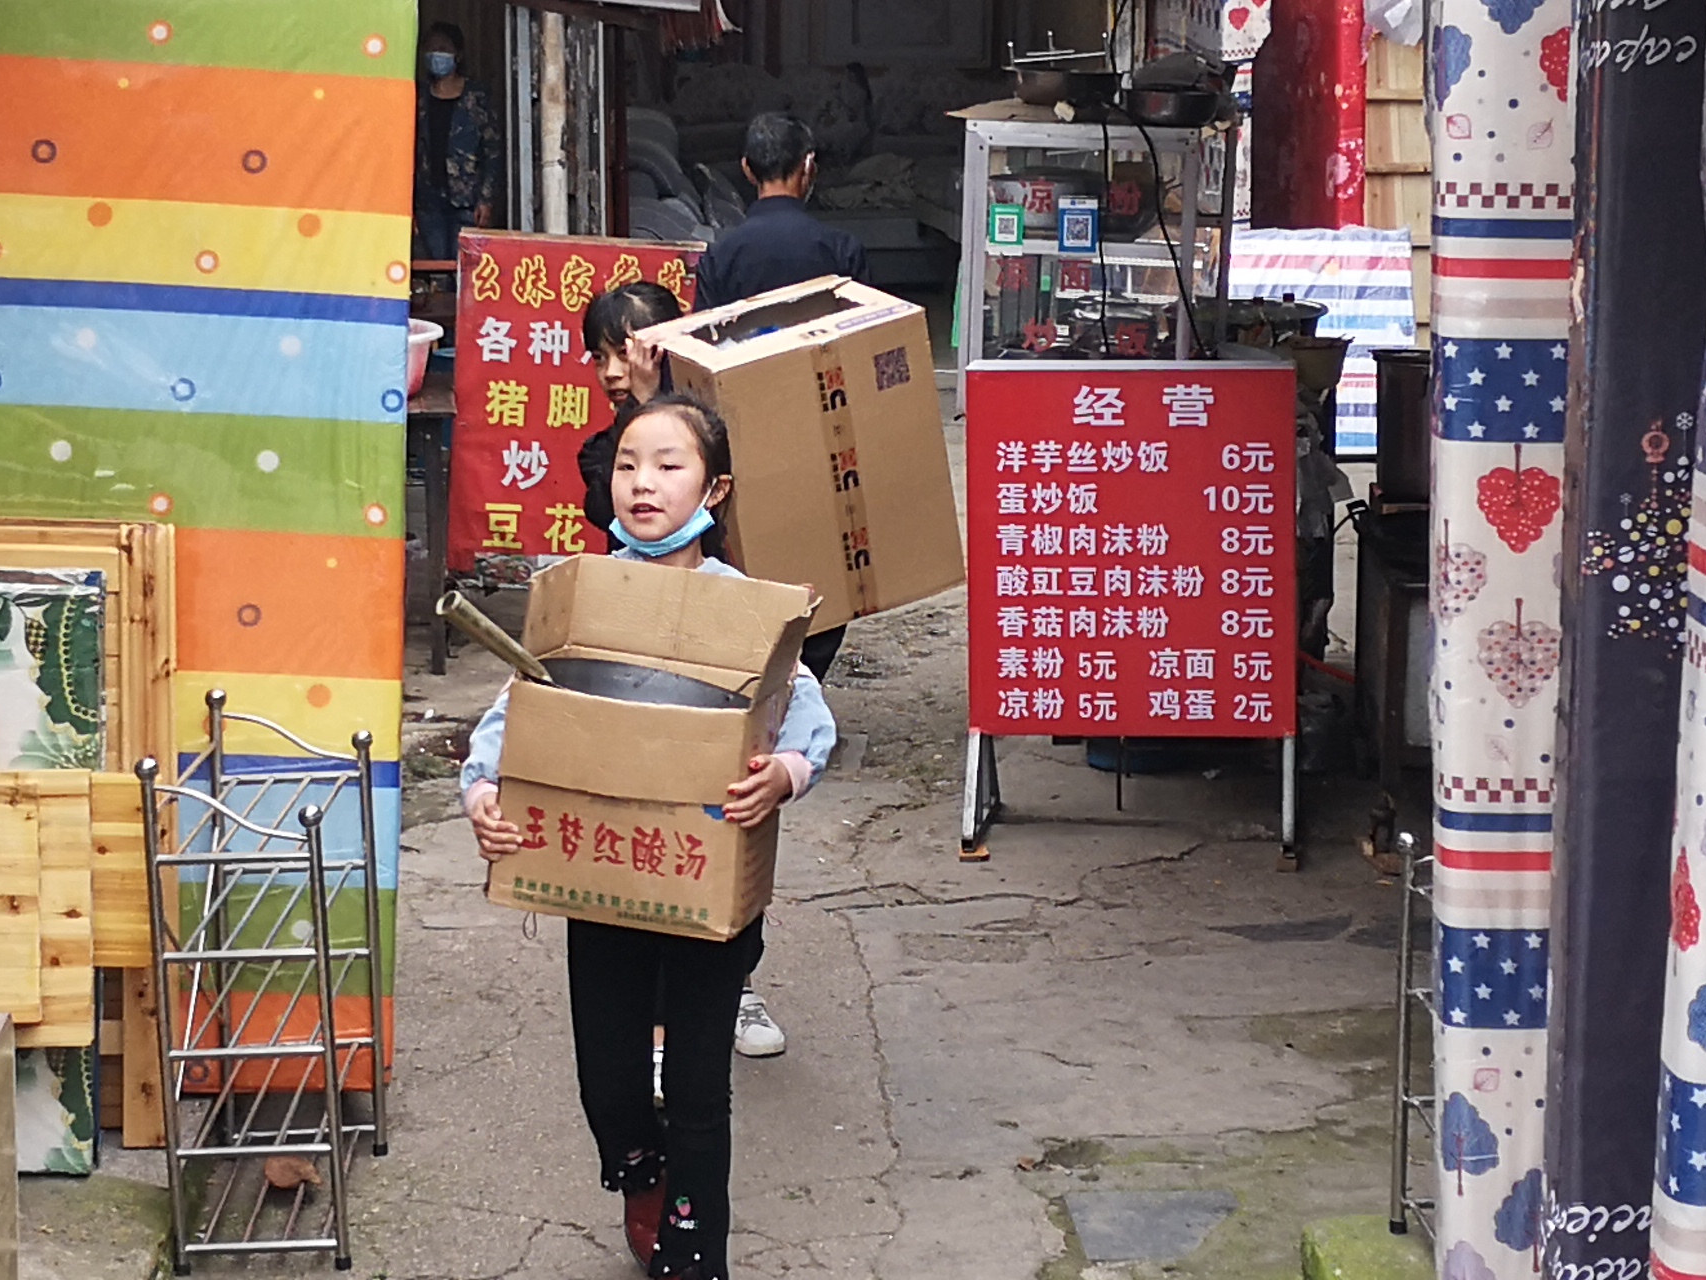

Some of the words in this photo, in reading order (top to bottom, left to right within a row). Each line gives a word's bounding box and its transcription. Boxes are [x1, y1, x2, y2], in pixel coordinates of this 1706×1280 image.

[476, 317, 592, 365] 各种
[1072, 384, 1214, 427] 经营
[996, 440, 1169, 473] 洋芋丝炒饭
[1221, 442, 1275, 473] 6元
[996, 483, 1098, 514] 蛋炒饭
[1203, 485, 1274, 514] 10元
[482, 502, 587, 553] 豆花
[996, 524, 1169, 556] 青椒肉沫粉
[1221, 526, 1274, 556] 8元
[996, 565, 1205, 597] 酸豇豆肉沫粉
[1221, 567, 1274, 597] 8元
[997, 606, 1169, 638] 香菇肉沫粉
[1221, 608, 1274, 638] 8元
[997, 647, 1064, 679] 素粉
[1078, 651, 1117, 680] 5元
[1149, 647, 1216, 679] 凉面
[1233, 651, 1272, 680] 5元
[998, 688, 1065, 719] 凉粉
[1078, 692, 1117, 721] 5元
[1149, 688, 1216, 720] 鸡蛋
[1233, 693, 1272, 722] 2元
